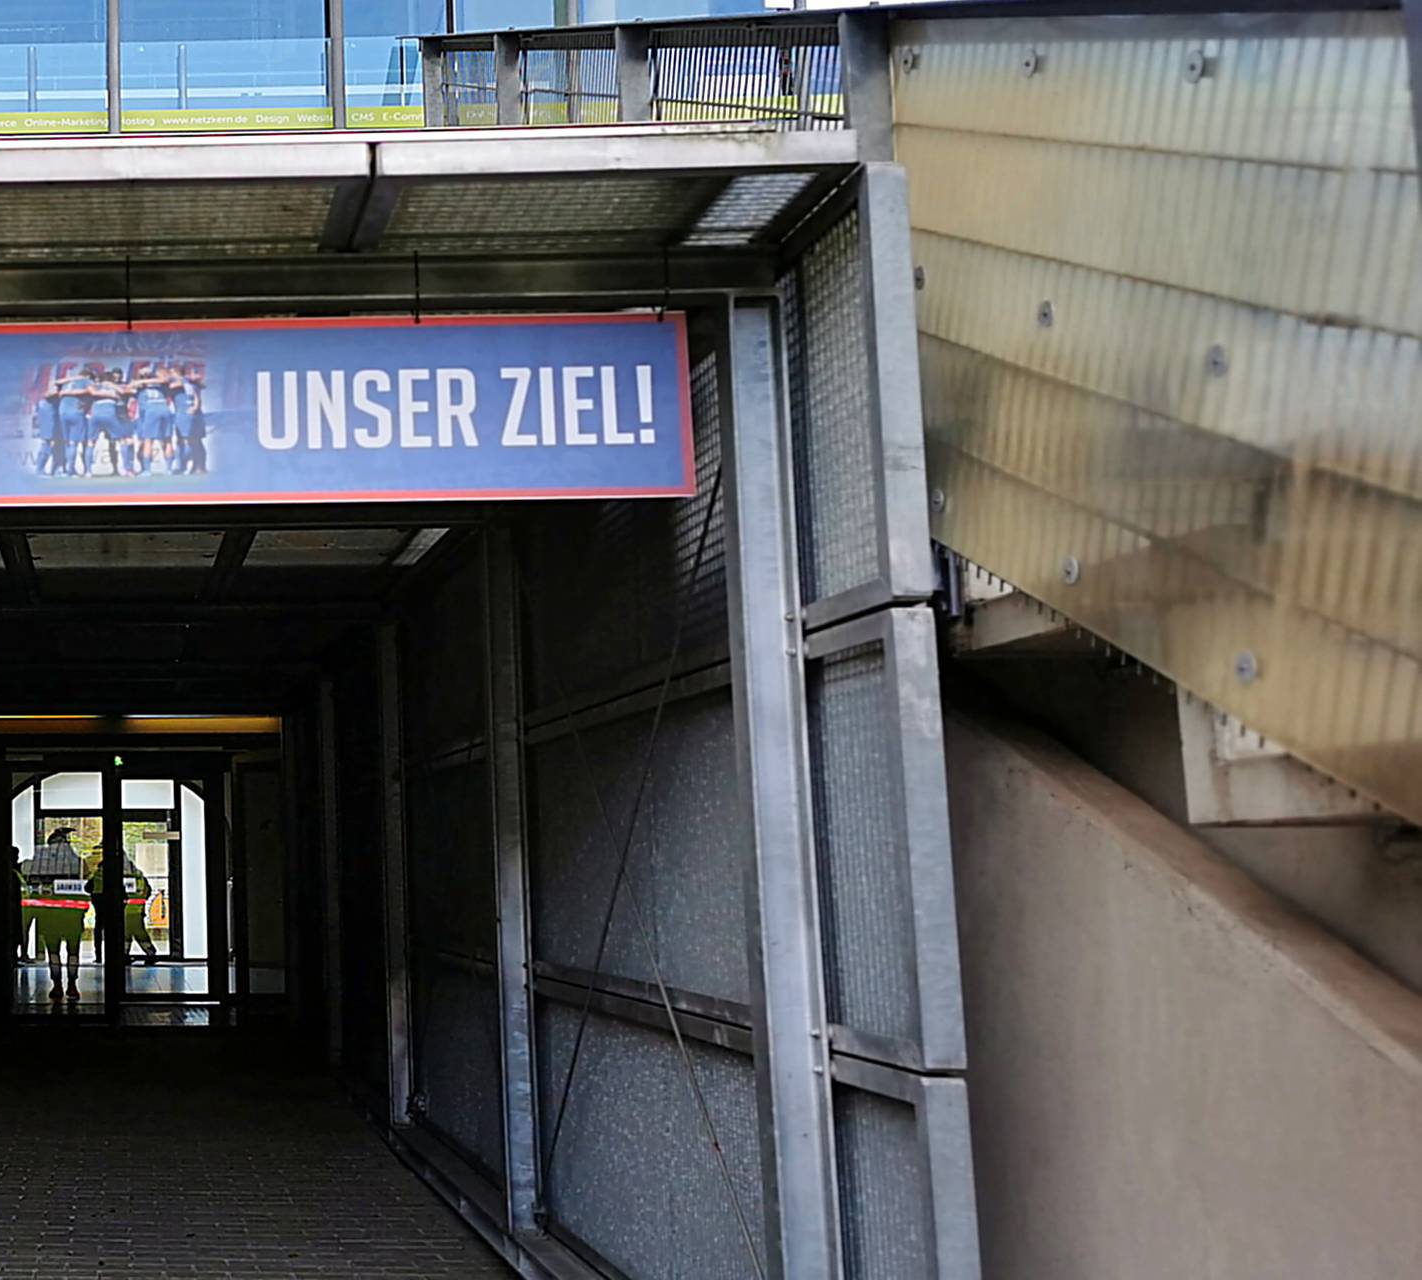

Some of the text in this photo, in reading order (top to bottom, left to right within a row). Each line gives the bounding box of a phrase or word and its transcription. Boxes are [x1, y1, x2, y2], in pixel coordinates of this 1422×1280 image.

[24, 117, 108, 130] Online-Marketing
[161, 113, 248, 126] www.netzkern.de
[255, 113, 289, 126] Design
[351, 112, 375, 122] CMS
[256, 367, 479, 450] UNSER
[500, 364, 655, 447] ZIEL!
